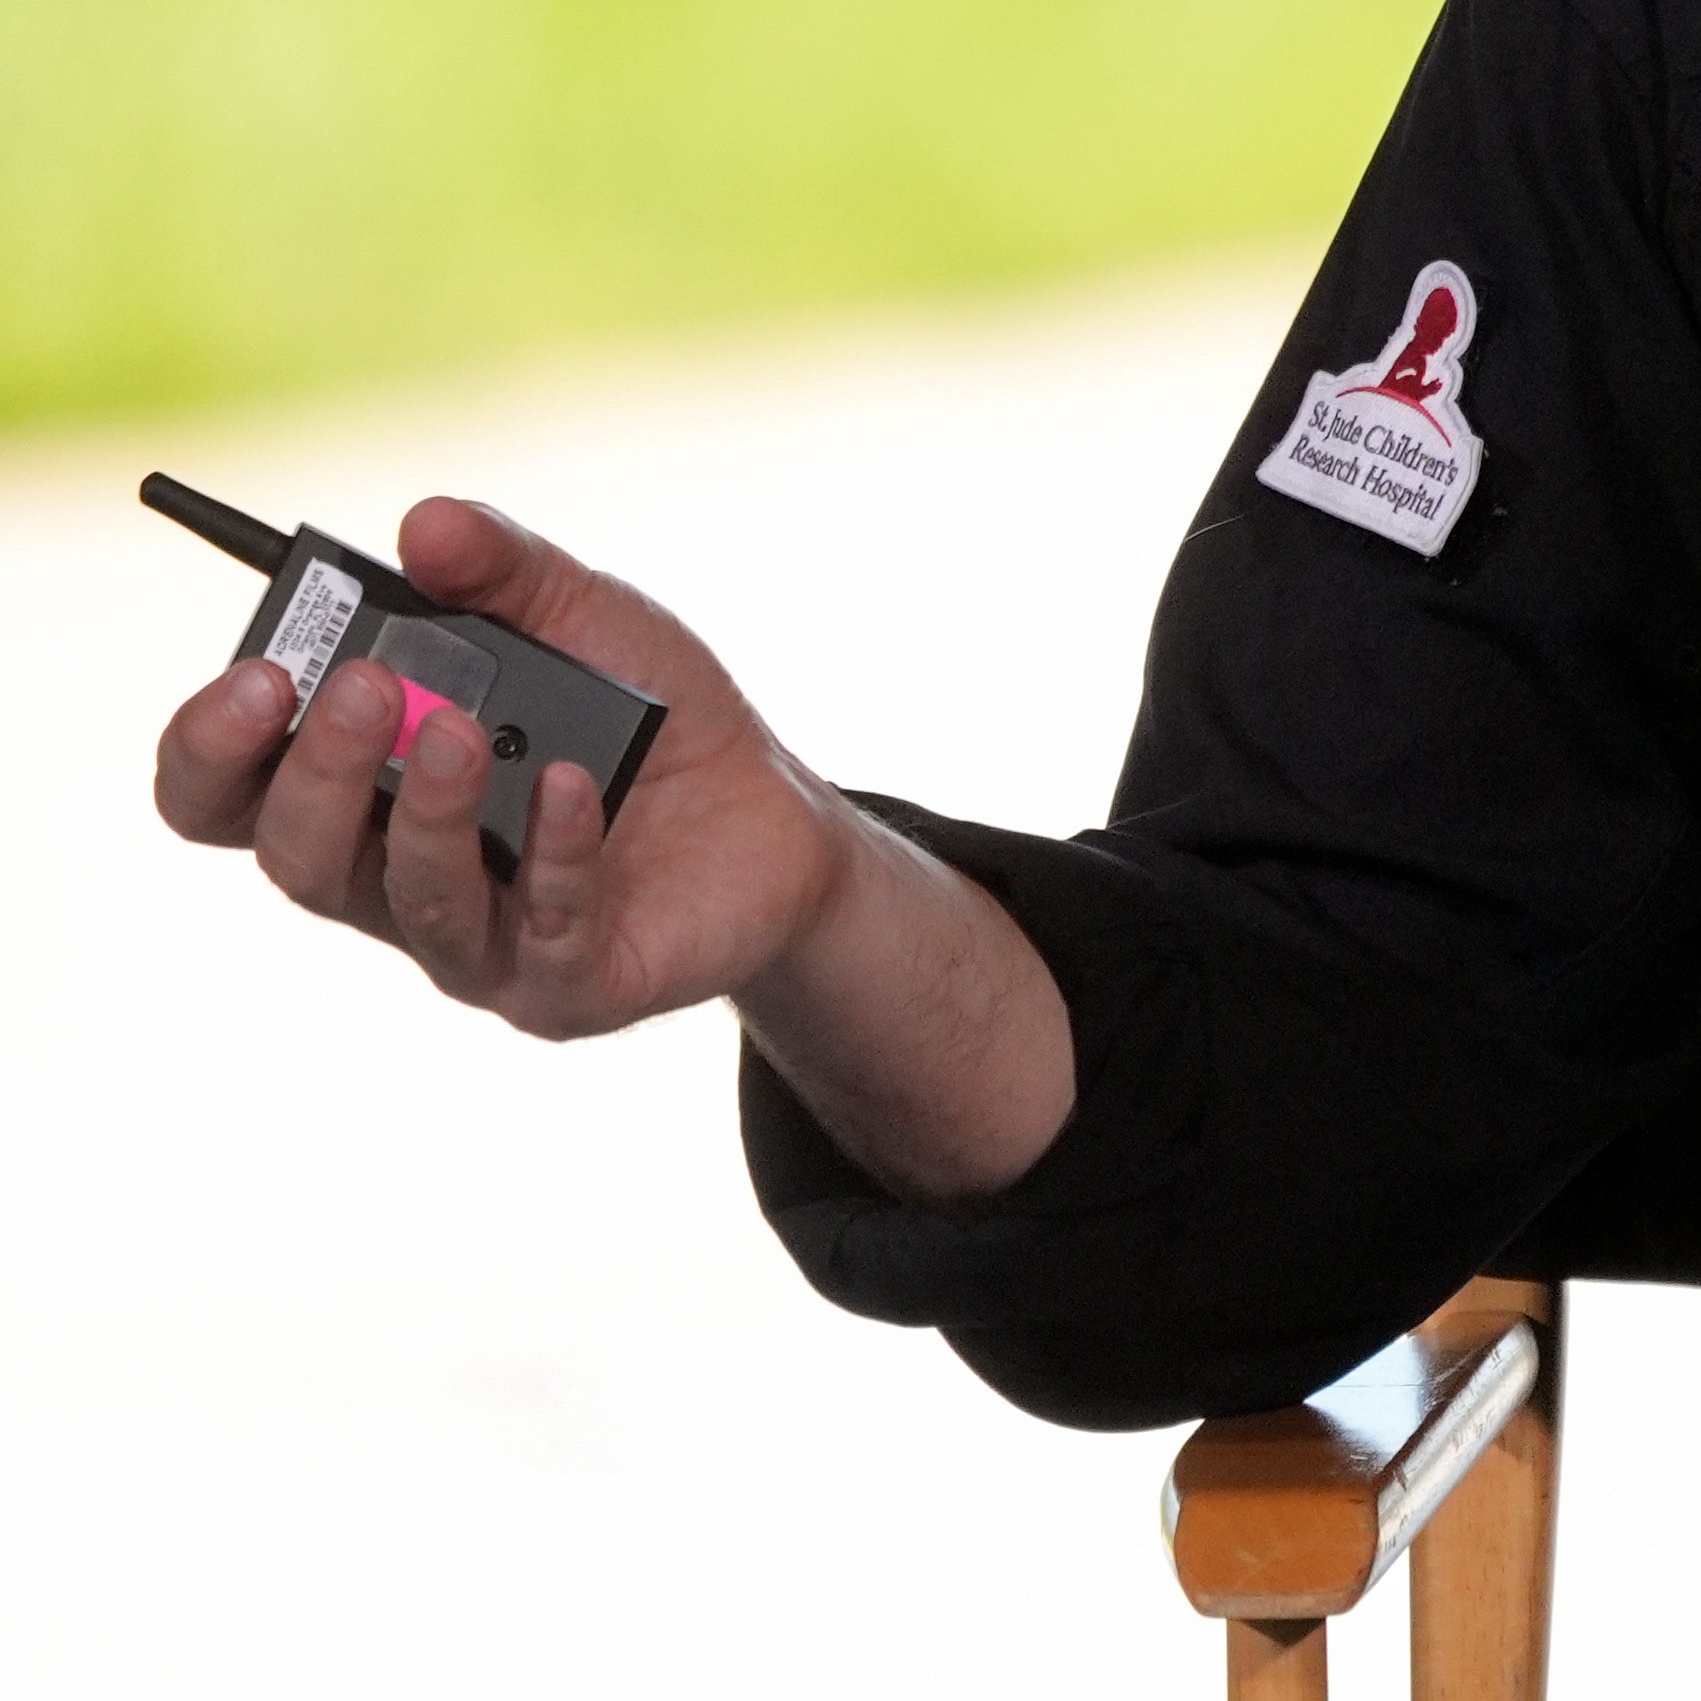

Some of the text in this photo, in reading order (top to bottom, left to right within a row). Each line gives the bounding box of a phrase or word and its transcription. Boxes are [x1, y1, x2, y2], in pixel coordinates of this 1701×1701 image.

[1289, 434, 1445, 520] Research Hospital
[1323, 409, 1363, 445] Jude
[1364, 425, 1459, 487] Children's
[302, 568, 324, 597] FILMS
